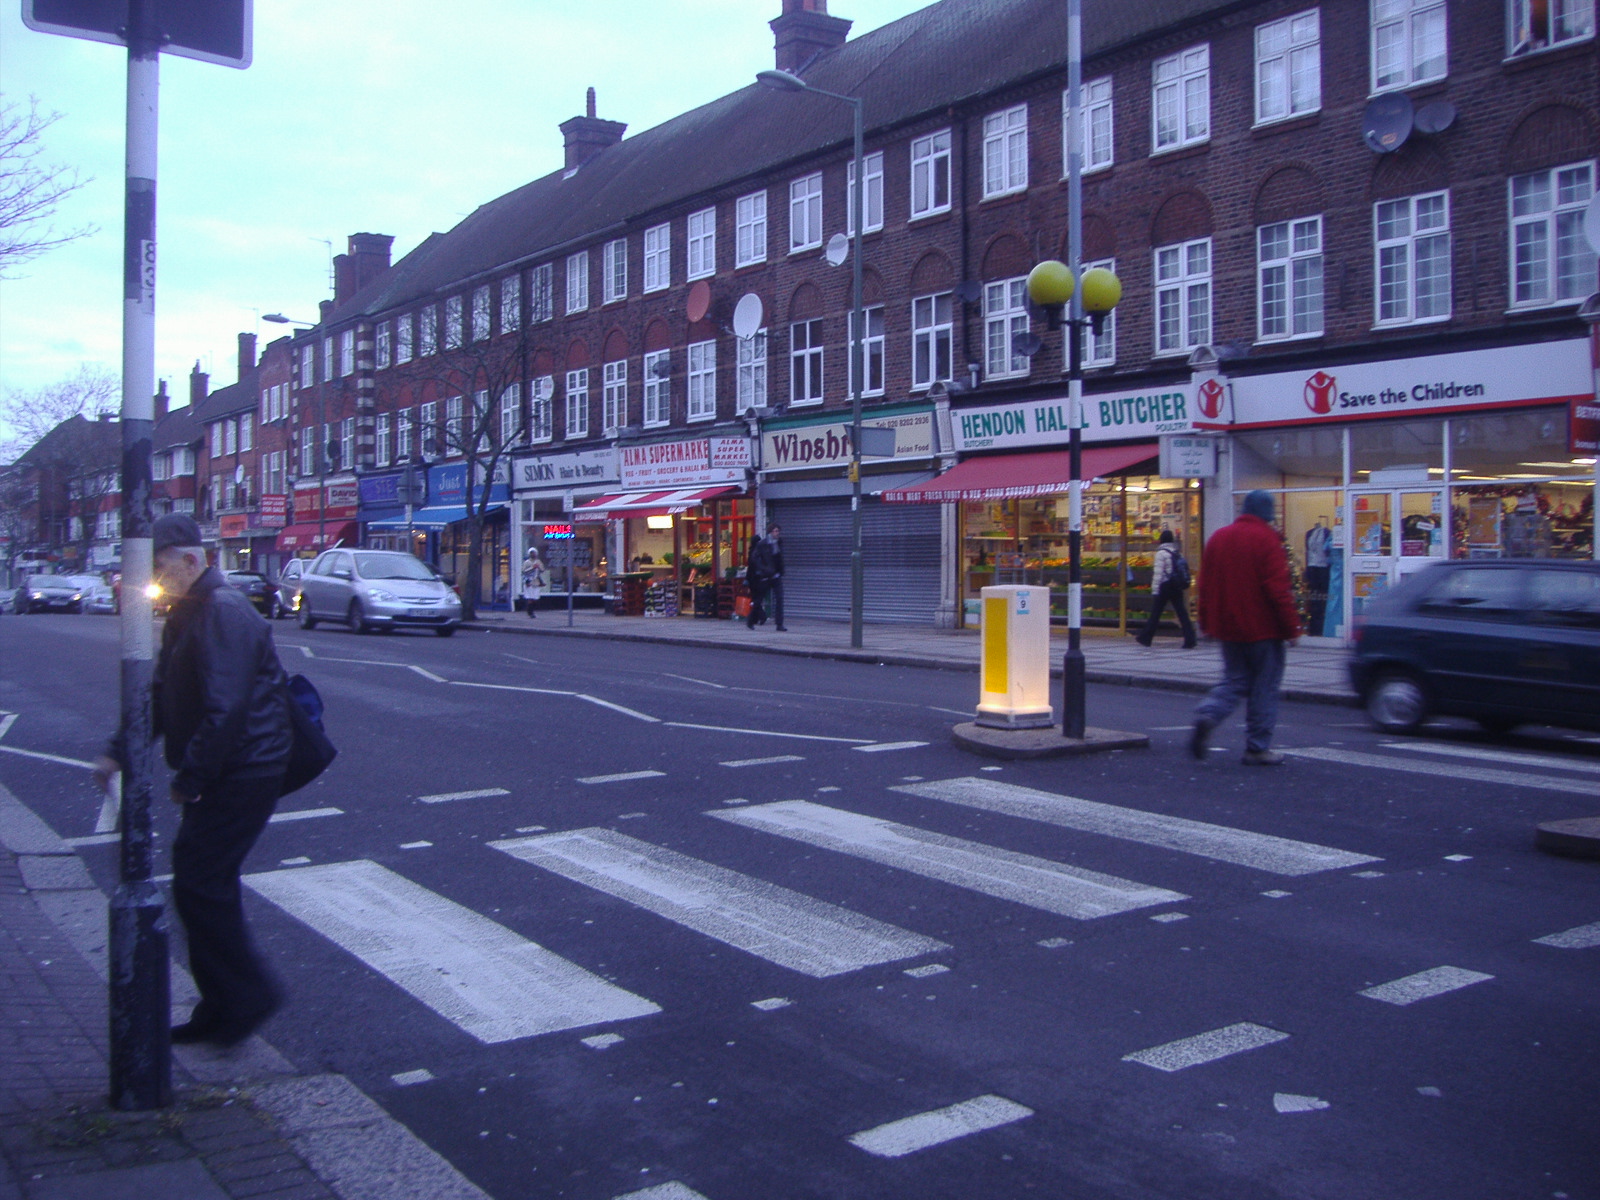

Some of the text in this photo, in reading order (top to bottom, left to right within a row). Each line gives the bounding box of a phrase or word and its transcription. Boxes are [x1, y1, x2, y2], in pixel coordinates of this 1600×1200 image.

[1339, 381, 1484, 408] Save the Children
[961, 393, 1188, 439] HENDON HALL BUTCHER
[887, 420, 898, 428] 020
[899, 418, 913, 427] 8202
[1155, 422, 1188, 432] POULTRY
[897, 444, 929, 454] Asian Food
[964, 439, 994, 449] BUTCHERY
[649, 440, 709, 464] SUPERMARKE
[524, 463, 555, 482] SIMON
[560, 466, 574, 479] Hair
[582, 464, 604, 479] Beauty
[638, 468, 652, 476] FRUIT
[657, 466, 679, 475] GROCERY
[439, 472, 461, 491] Just
[332, 490, 358, 498] DAVID
[906, 491, 921, 501] MEAT
[943, 490, 960, 499] FRUIT
[544, 524, 571, 534] NAILS
[1020, 600, 1026, 609] 9
